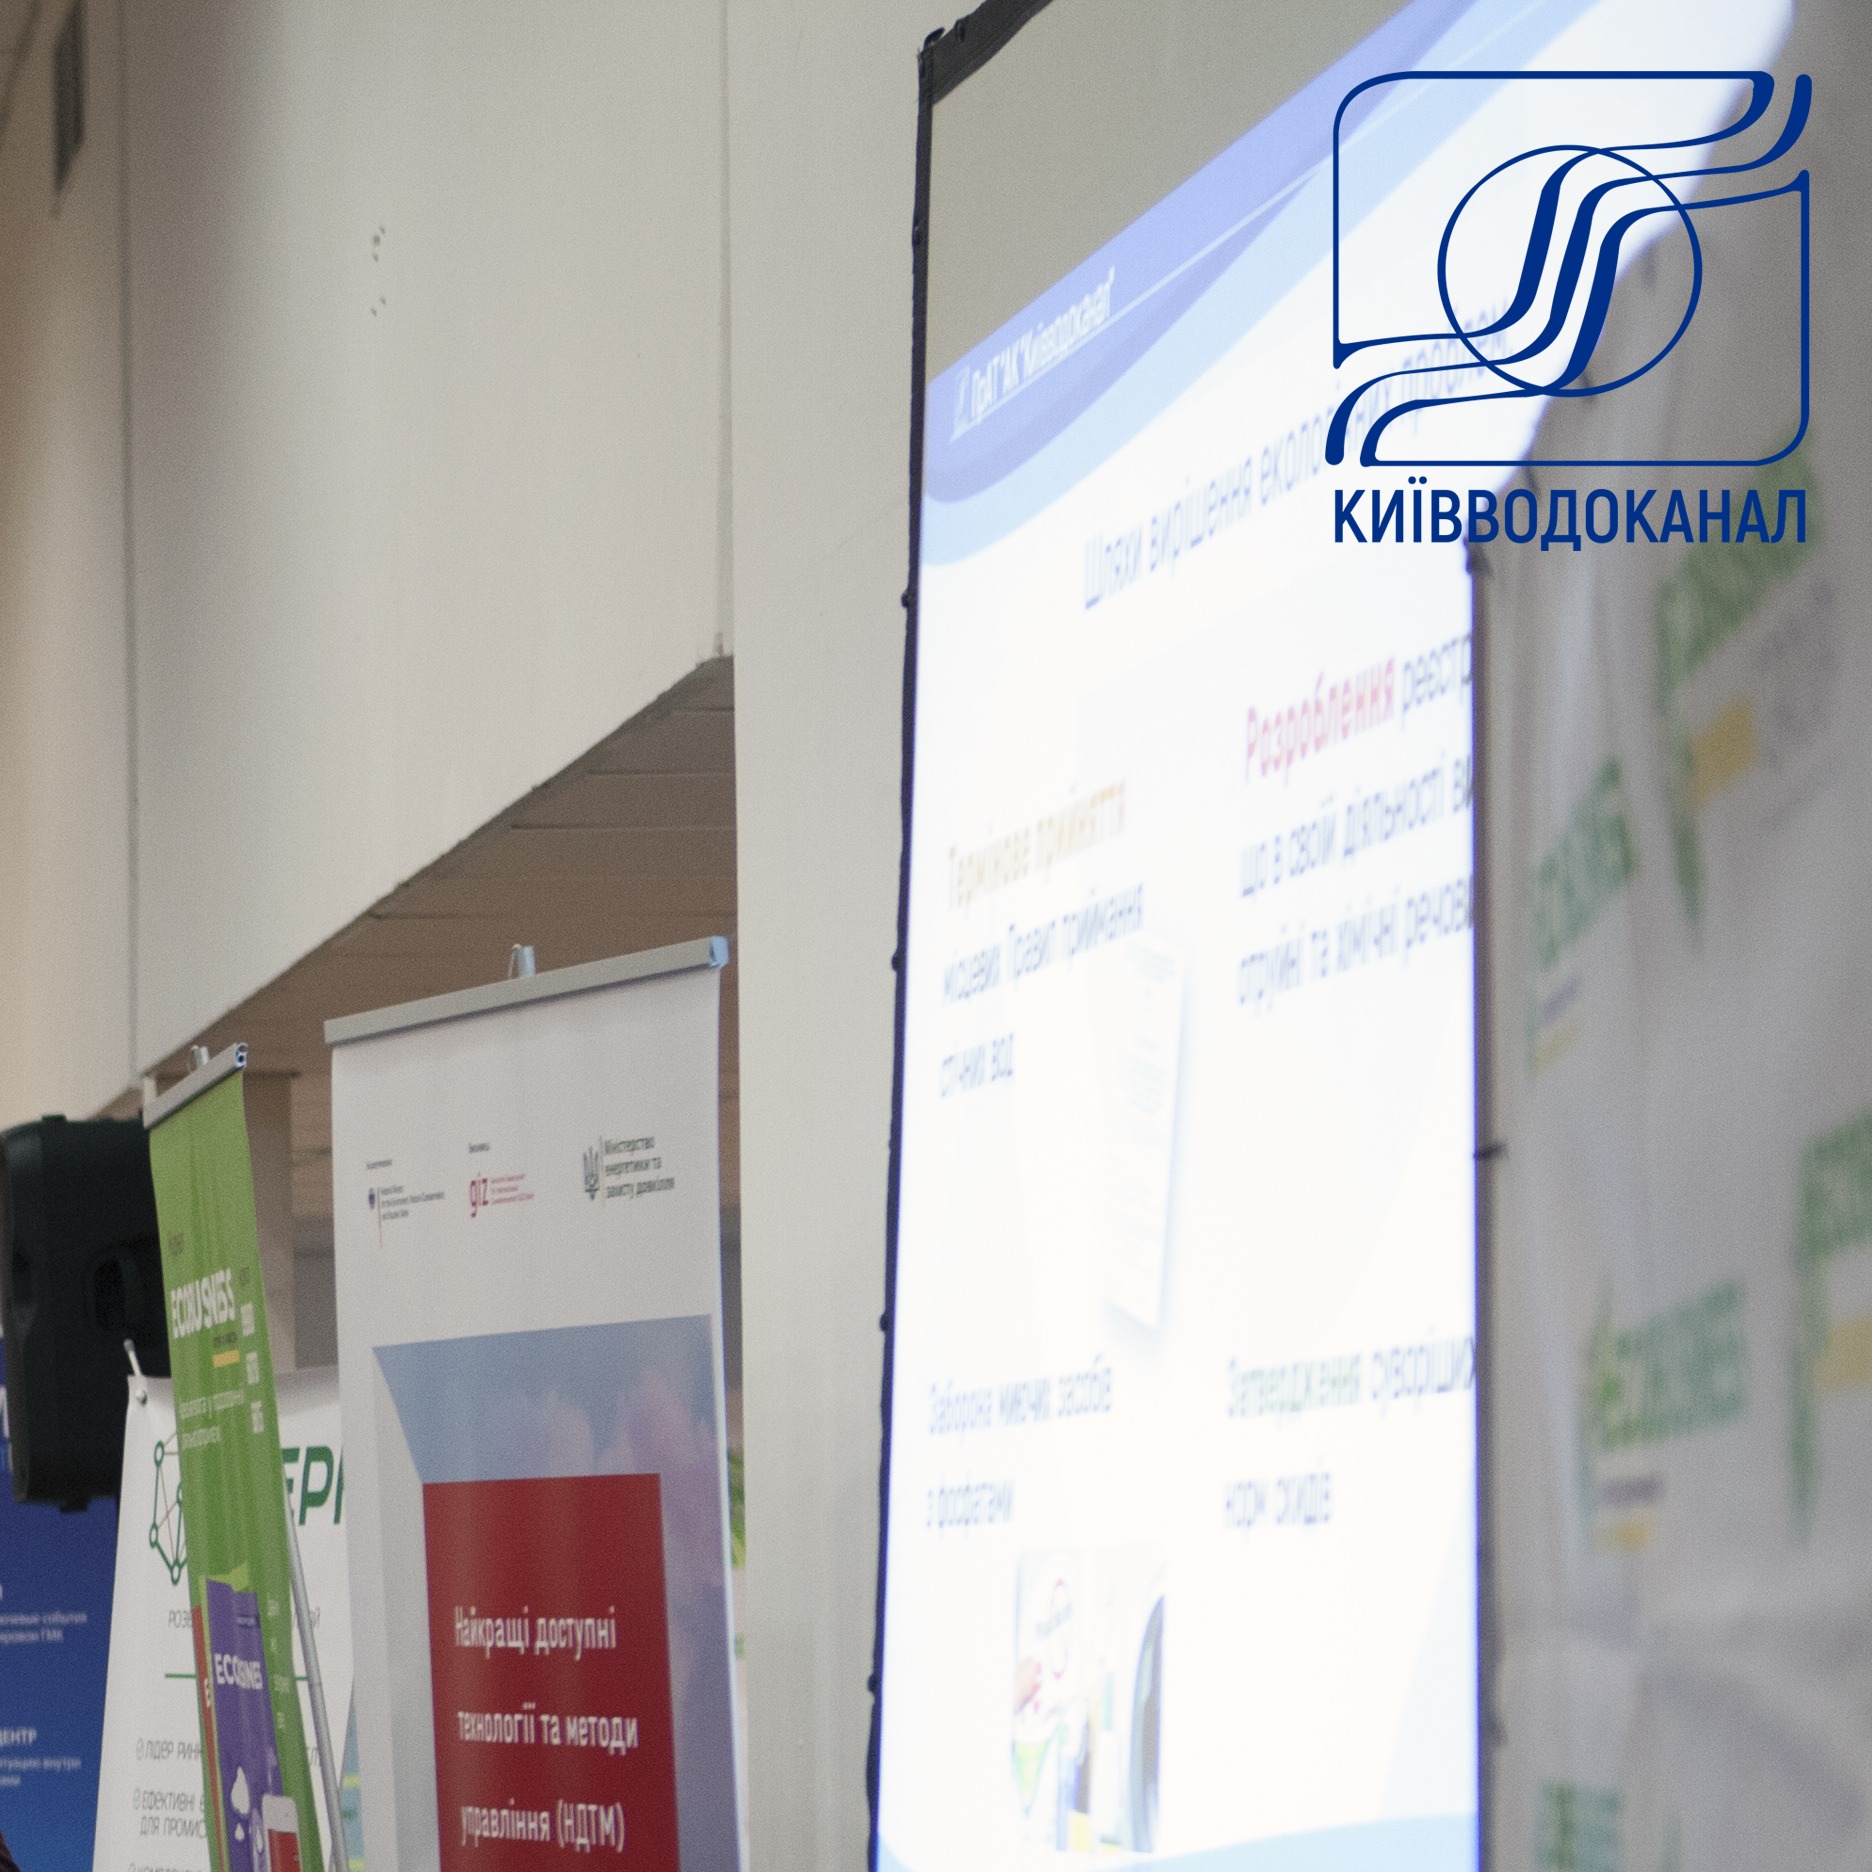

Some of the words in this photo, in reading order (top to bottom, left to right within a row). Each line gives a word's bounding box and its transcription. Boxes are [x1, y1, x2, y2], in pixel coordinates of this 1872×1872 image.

[454, 1605, 530, 1660] Найкращі
[534, 1605, 618, 1662] доступні
[457, 1701, 537, 1745] технології
[539, 1713, 562, 1746] та
[565, 1715, 639, 1756] методи
[460, 1797, 551, 1848] управління
[555, 1798, 626, 1853] (НДТМ)
